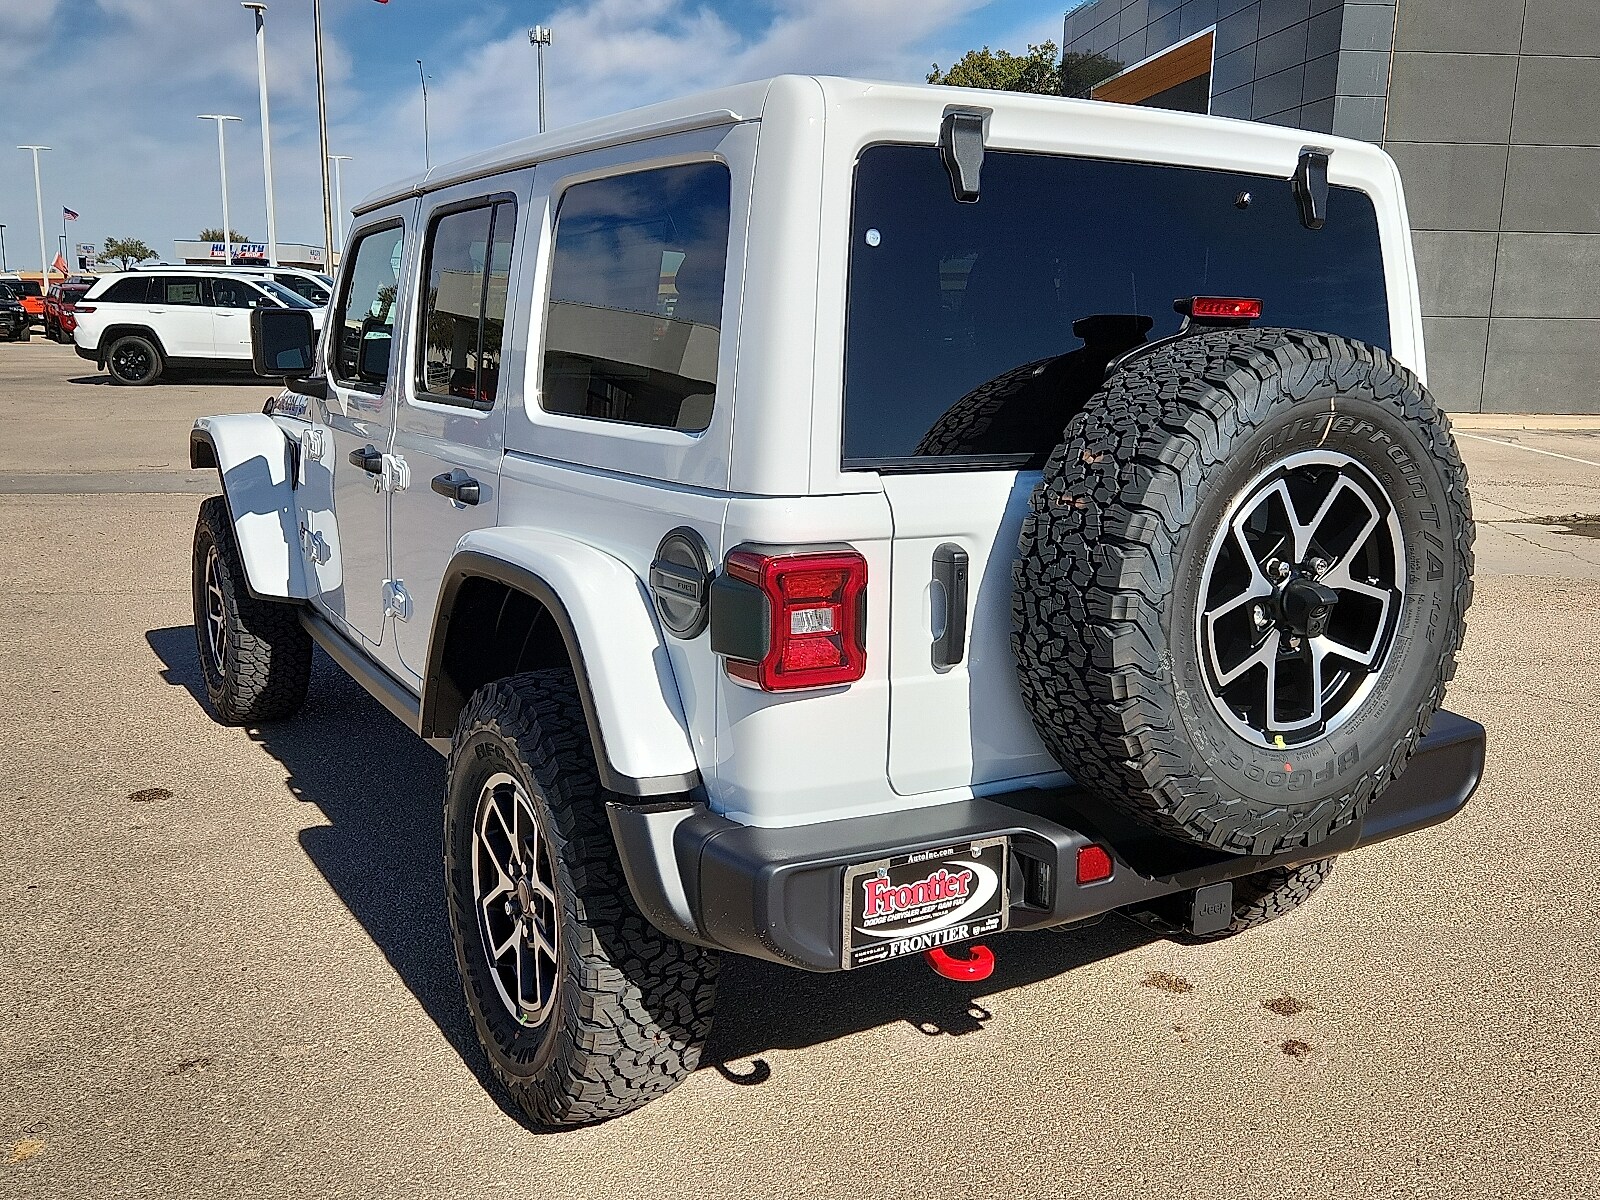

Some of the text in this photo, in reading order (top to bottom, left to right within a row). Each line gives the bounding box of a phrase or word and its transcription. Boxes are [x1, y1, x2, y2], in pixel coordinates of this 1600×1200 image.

[240, 244, 265, 253] CITY
[1252, 411, 1429, 499] All-Terrain
[1419, 503, 1445, 583] T/A
[677, 582, 694, 592] FUEL
[907, 848, 954, 863] AutoInc.com
[863, 869, 972, 918] Frontier
[863, 915, 888, 928] DODGE
[887, 908, 920, 923] CHRYSLER
[1199, 902, 1227, 917] Jeep
[888, 924, 970, 957] FRONTIER
